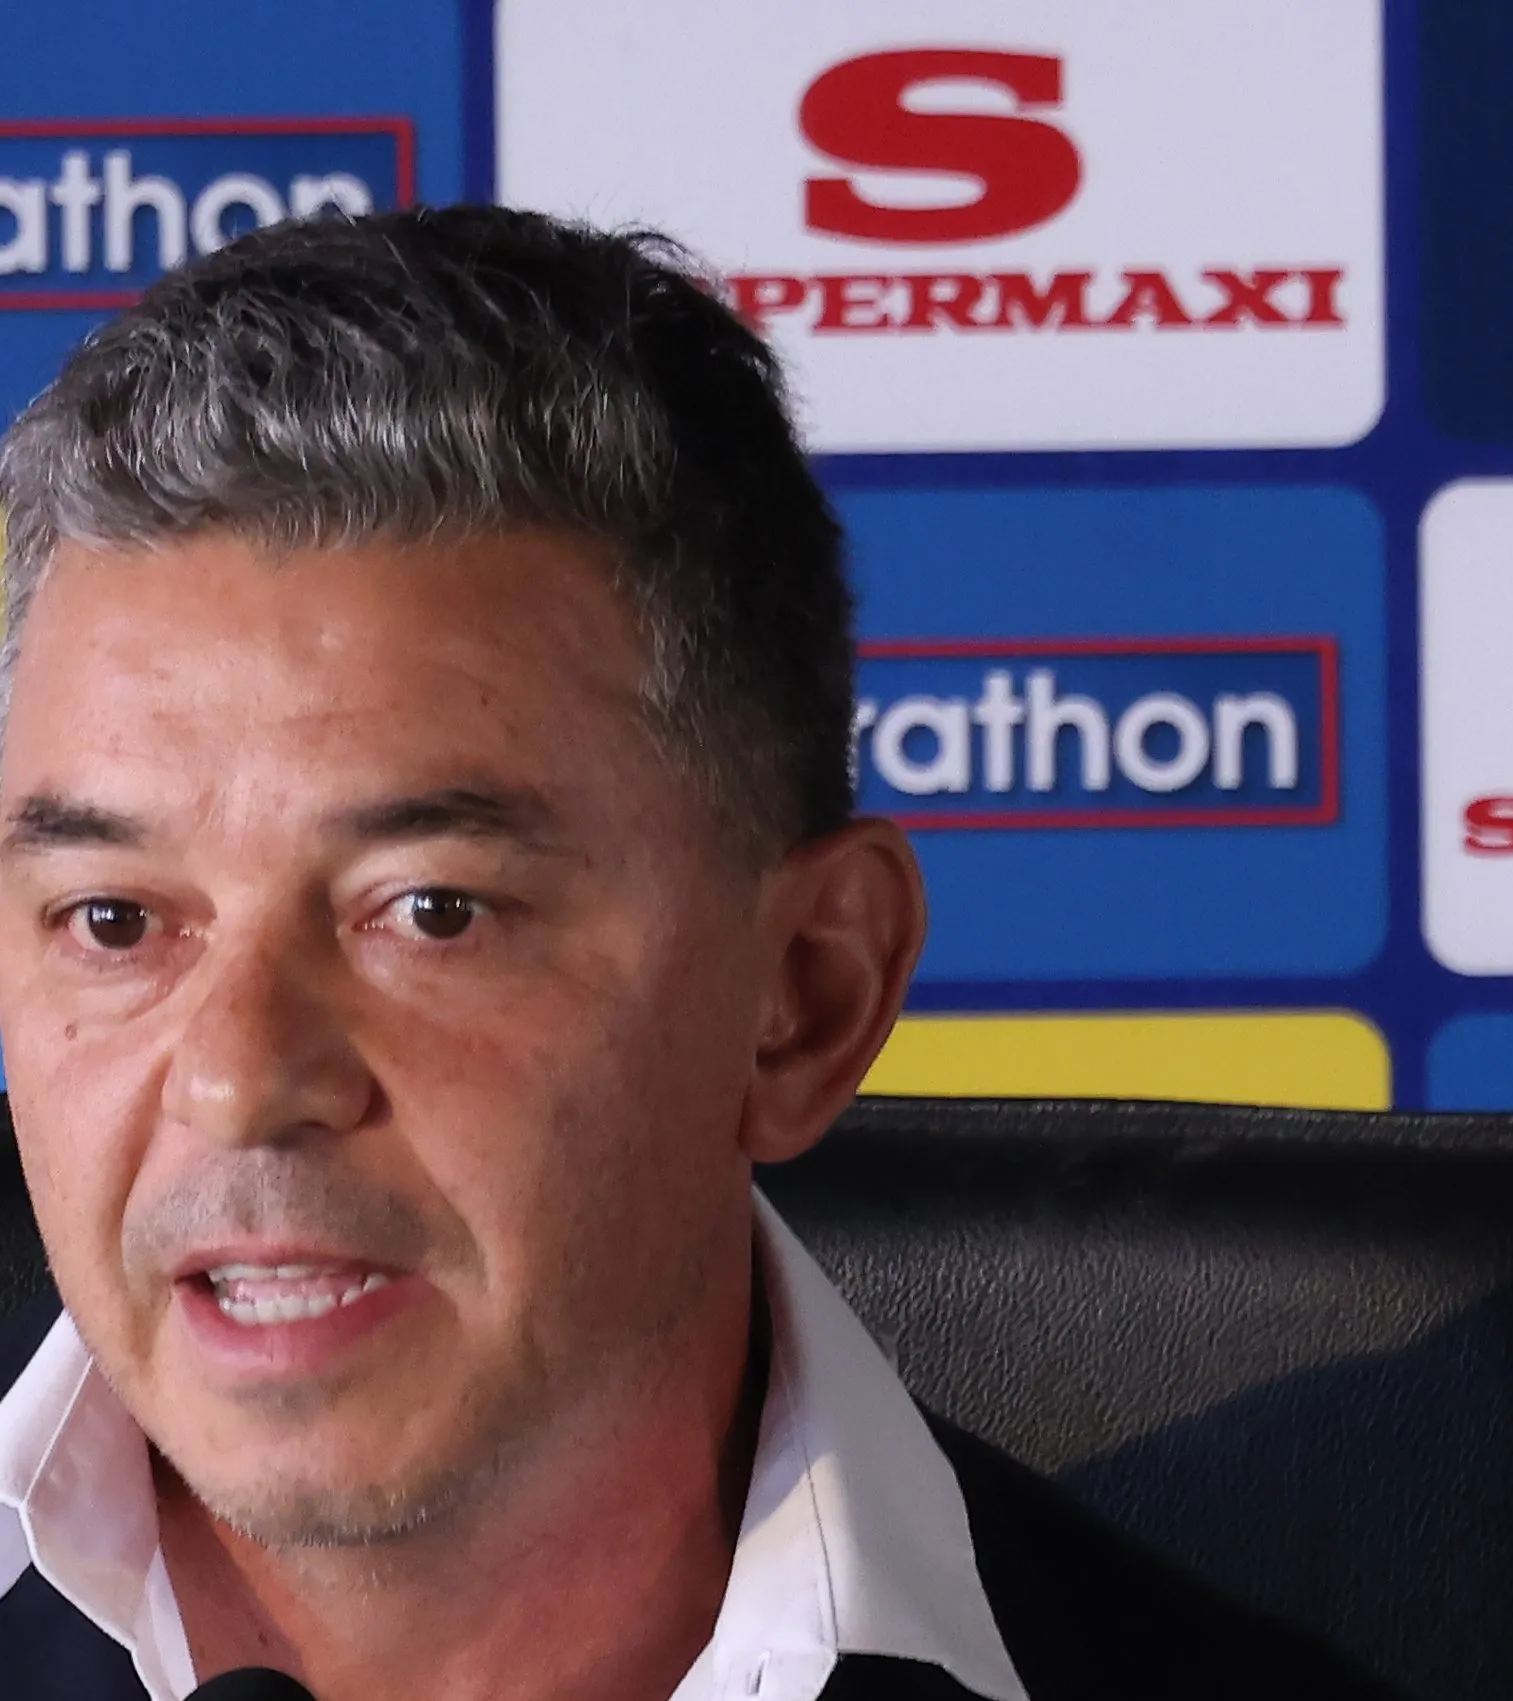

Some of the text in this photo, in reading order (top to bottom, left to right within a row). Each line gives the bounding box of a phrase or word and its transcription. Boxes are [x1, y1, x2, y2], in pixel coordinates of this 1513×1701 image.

[797, 46, 1083, 249] S
[724, 267, 1348, 336] PERMAXI
[849, 668, 1298, 796] rathon
